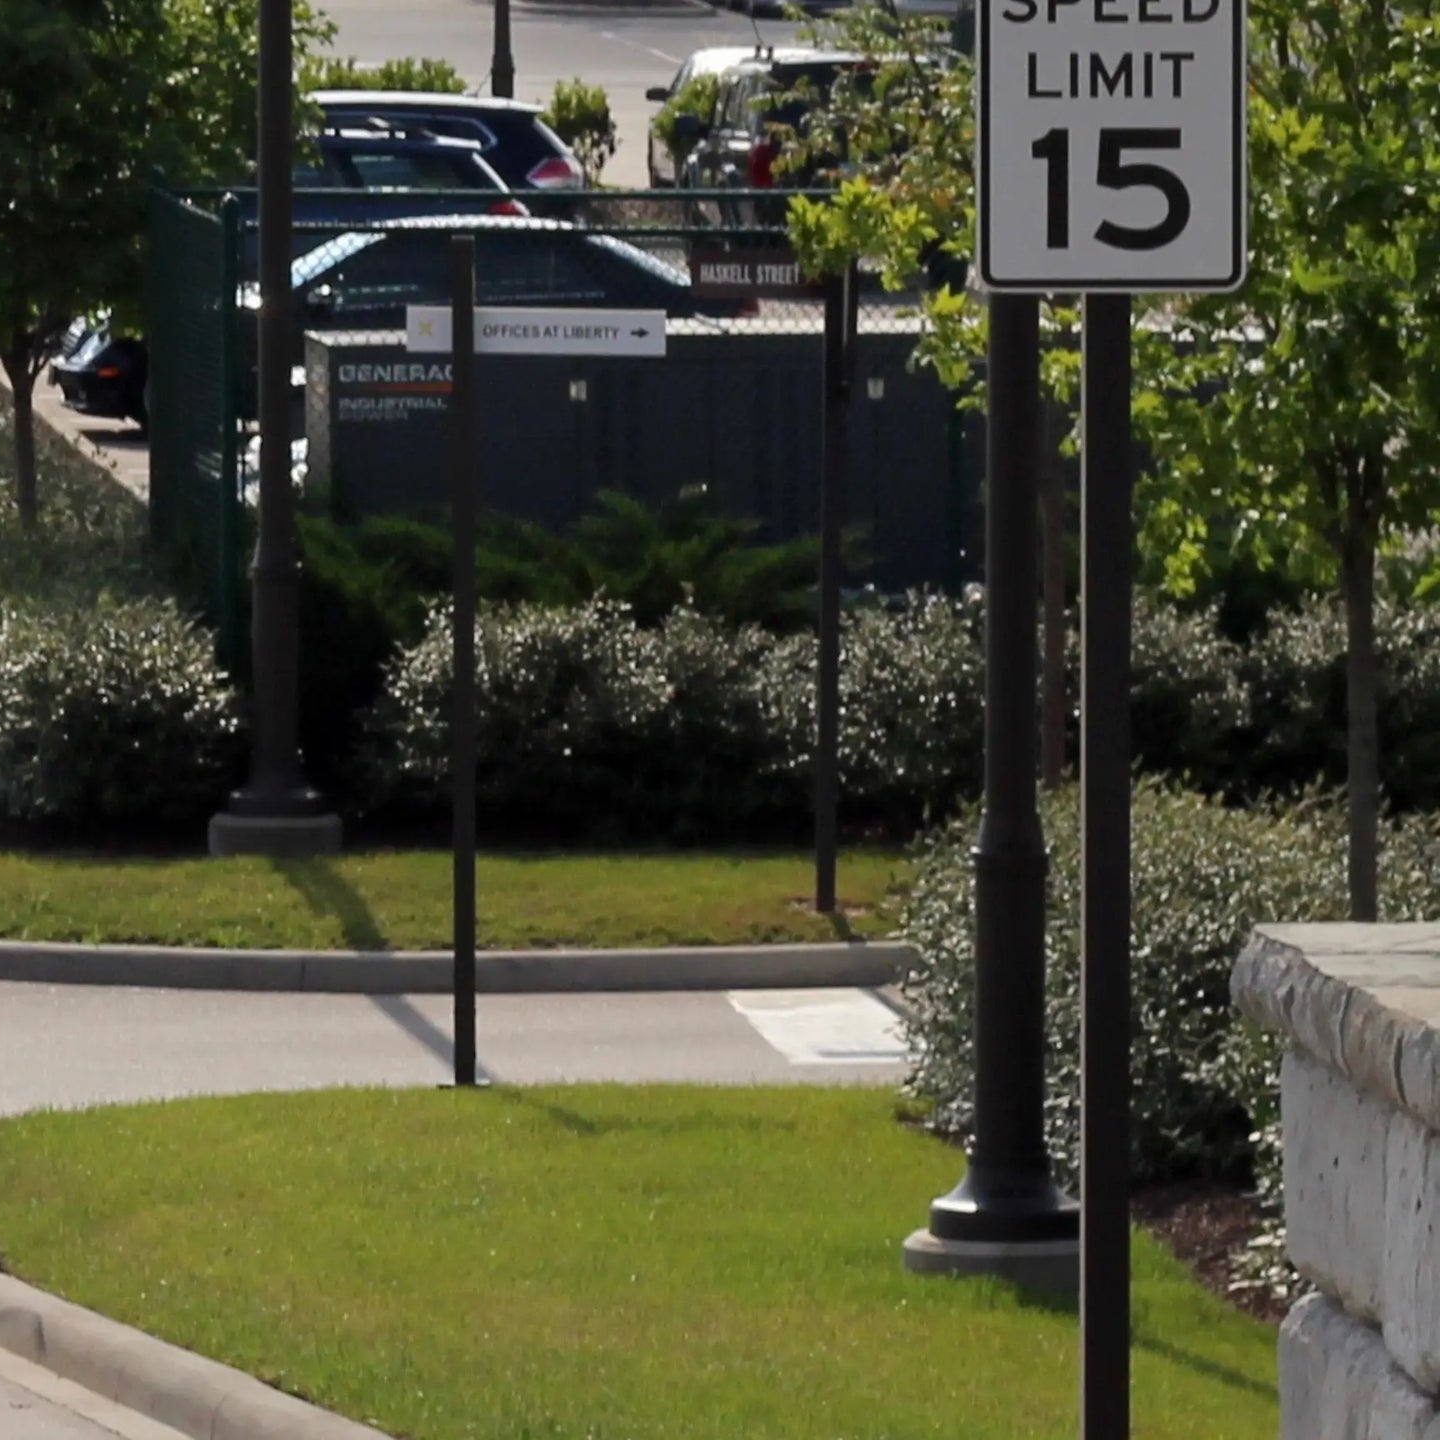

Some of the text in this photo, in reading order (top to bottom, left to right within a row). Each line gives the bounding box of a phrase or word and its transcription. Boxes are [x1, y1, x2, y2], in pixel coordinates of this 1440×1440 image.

[1027, 52, 1195, 99] LIMIT
[1031, 127, 1192, 251] 15
[700, 262, 800, 285] HASKELL STREET
[482, 323, 620, 340] OFFICES AT LIBERTY
